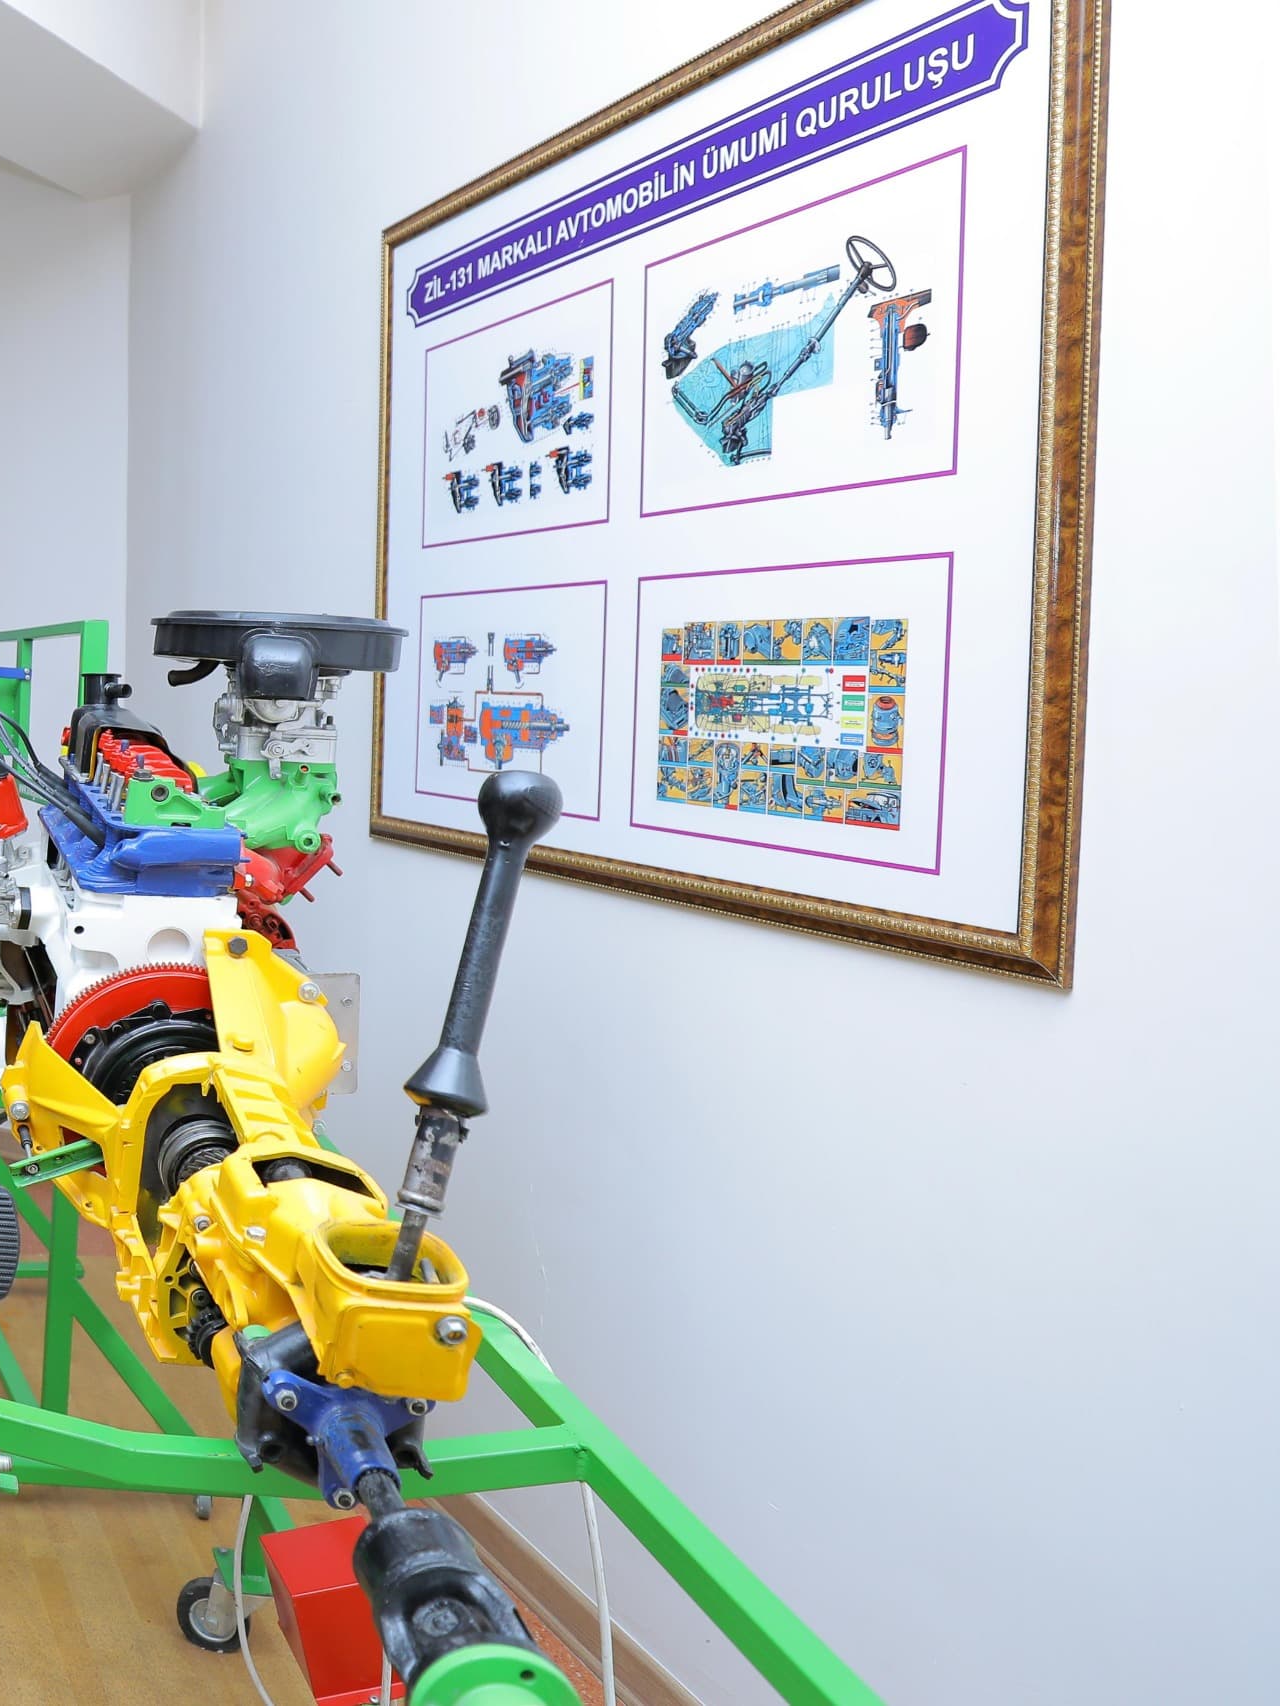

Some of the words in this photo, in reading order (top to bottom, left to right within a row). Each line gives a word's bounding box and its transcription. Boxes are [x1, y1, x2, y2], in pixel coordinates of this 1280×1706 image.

[423, 262, 474, 304] ZİL-131
[477, 226, 553, 281] MARKALI
[555, 159, 696, 246] AVTOMOBİLİN
[702, 111, 788, 180] ÜMUMİ
[795, 32, 976, 139] QURULUŞU
